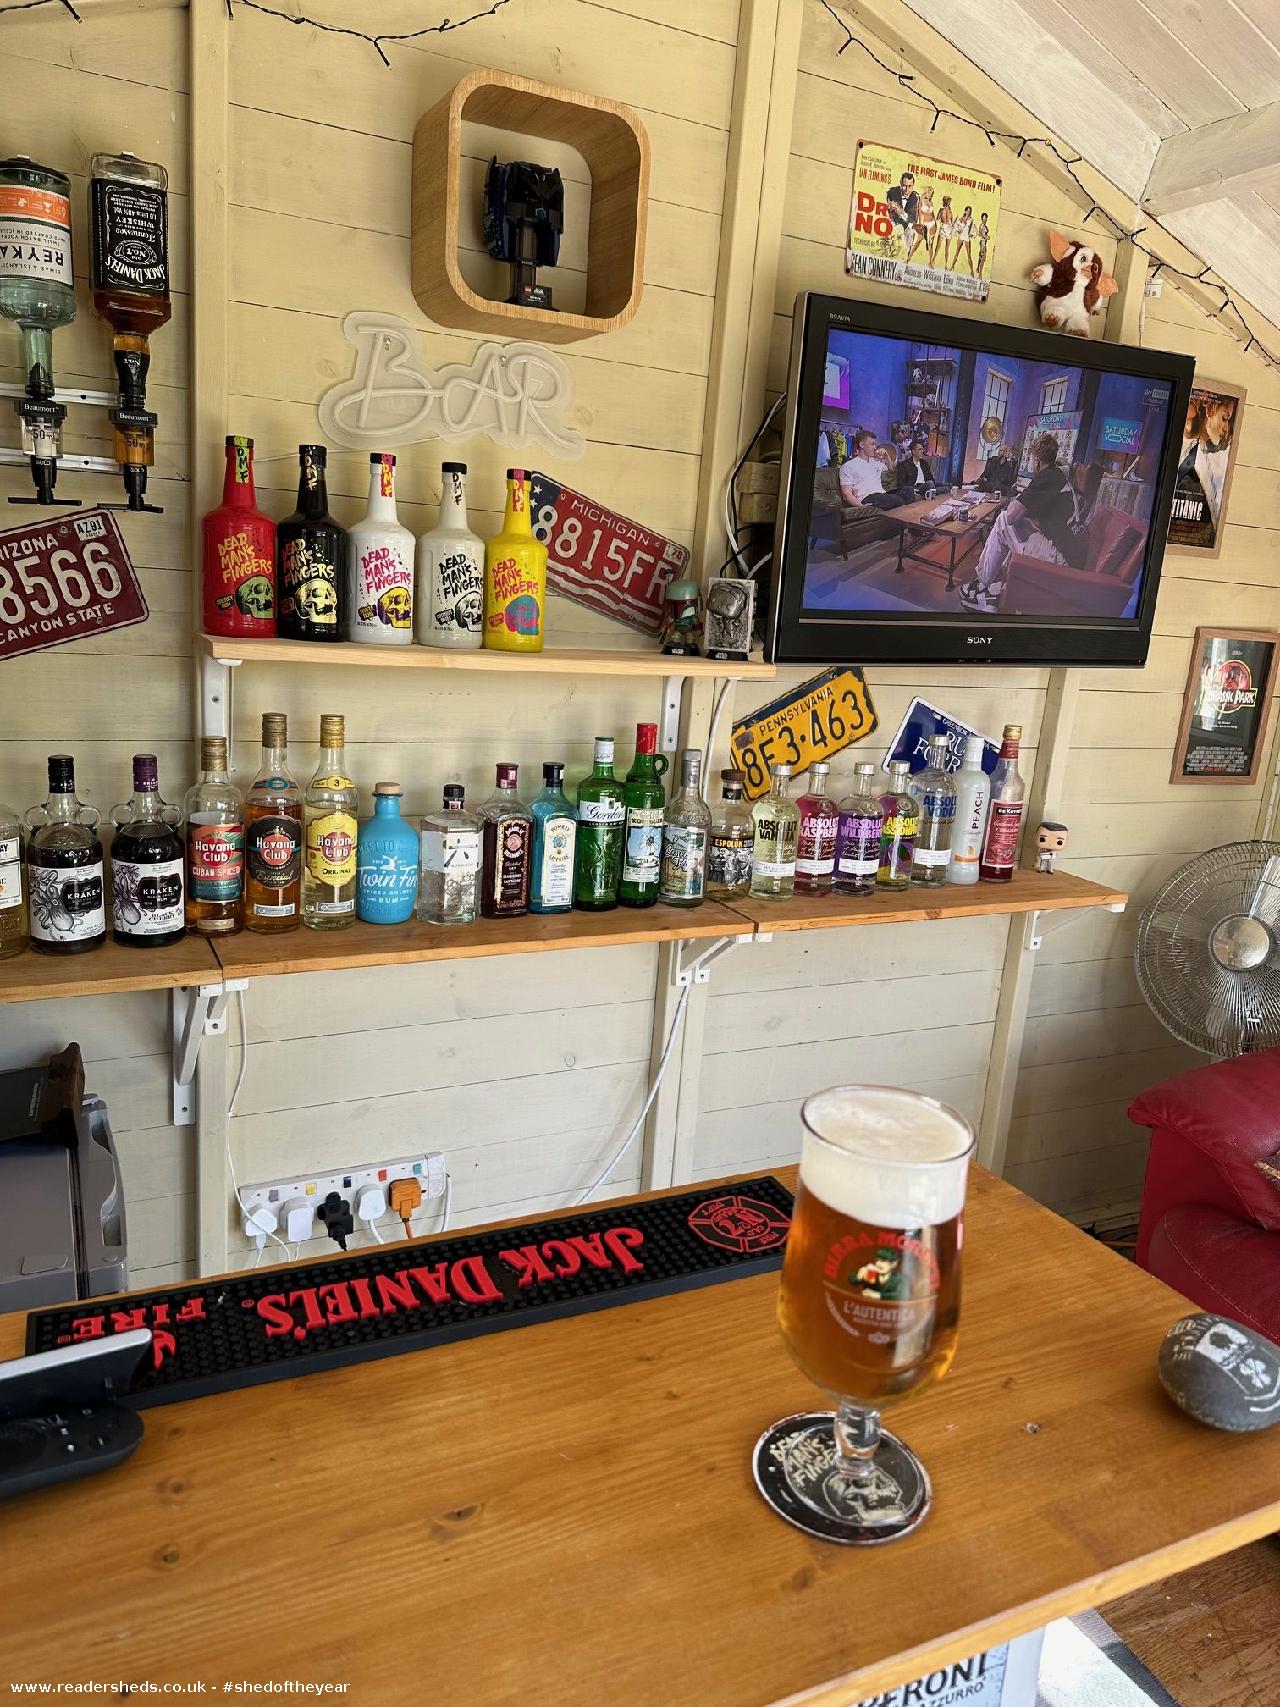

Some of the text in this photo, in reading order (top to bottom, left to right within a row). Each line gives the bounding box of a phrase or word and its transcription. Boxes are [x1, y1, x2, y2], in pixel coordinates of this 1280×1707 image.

[907, 163, 919, 175] THE
[920, 167, 938, 179] FIRST
[938, 171, 959, 185] JAMES
[959, 177, 977, 189] BOND
[857, 190, 889, 218] DR
[115, 216, 155, 229] WHISKEY
[854, 212, 894, 239] NO
[104, 254, 166, 284] JACK DANIEL'S
[334, 326, 581, 448] BAR
[1105, 424, 1138, 437] SATURDAY
[1171, 498, 1204, 522] TITANIC
[77, 519, 103, 535] AZ91
[570, 499, 650, 547] MICHIGAN
[217, 532, 248, 556] DEAD
[282, 538, 306, 558] DEAD
[221, 545, 256, 570] MAN'S
[360, 547, 390, 570] DEAD
[438, 553, 467, 576] DEAD
[491, 557, 517, 577] DEAD
[222, 558, 273, 584] FINGERS
[284, 563, 335, 588] FINGERS
[364, 560, 396, 582] MAN'S
[442, 565, 473, 588] MAN'S
[493, 567, 523, 591] MAN'S
[366, 571, 412, 595] FINGERS
[494, 580, 539, 602] FINGERS
[65, 602, 115, 626] STATE
[966, 636, 993, 646] SONY
[1234, 689, 1255, 705] PARK
[759, 687, 834, 737] PENNSYLVANIA
[334, 779, 340, 787] 3
[972, 791, 984, 830] PEACH
[195, 840, 236, 852] Havana
[256, 836, 297, 849] Havana
[317, 835, 356, 847] Havana
[325, 846, 349, 858] Club
[203, 851, 229, 863] Club
[263, 849, 288, 860] Club
[192, 866, 241, 878] CUBAN SPICED
[356, 864, 418, 888] Twin Fin
[143, 886, 179, 896] KRAKEN
[823, 1231, 874, 1281] BIRRA
[256, 1226, 646, 1342] JACK DANIEL'S
[71, 1297, 207, 1342] FIRE
[843, 1300, 916, 1322] L'AUTENTICA
